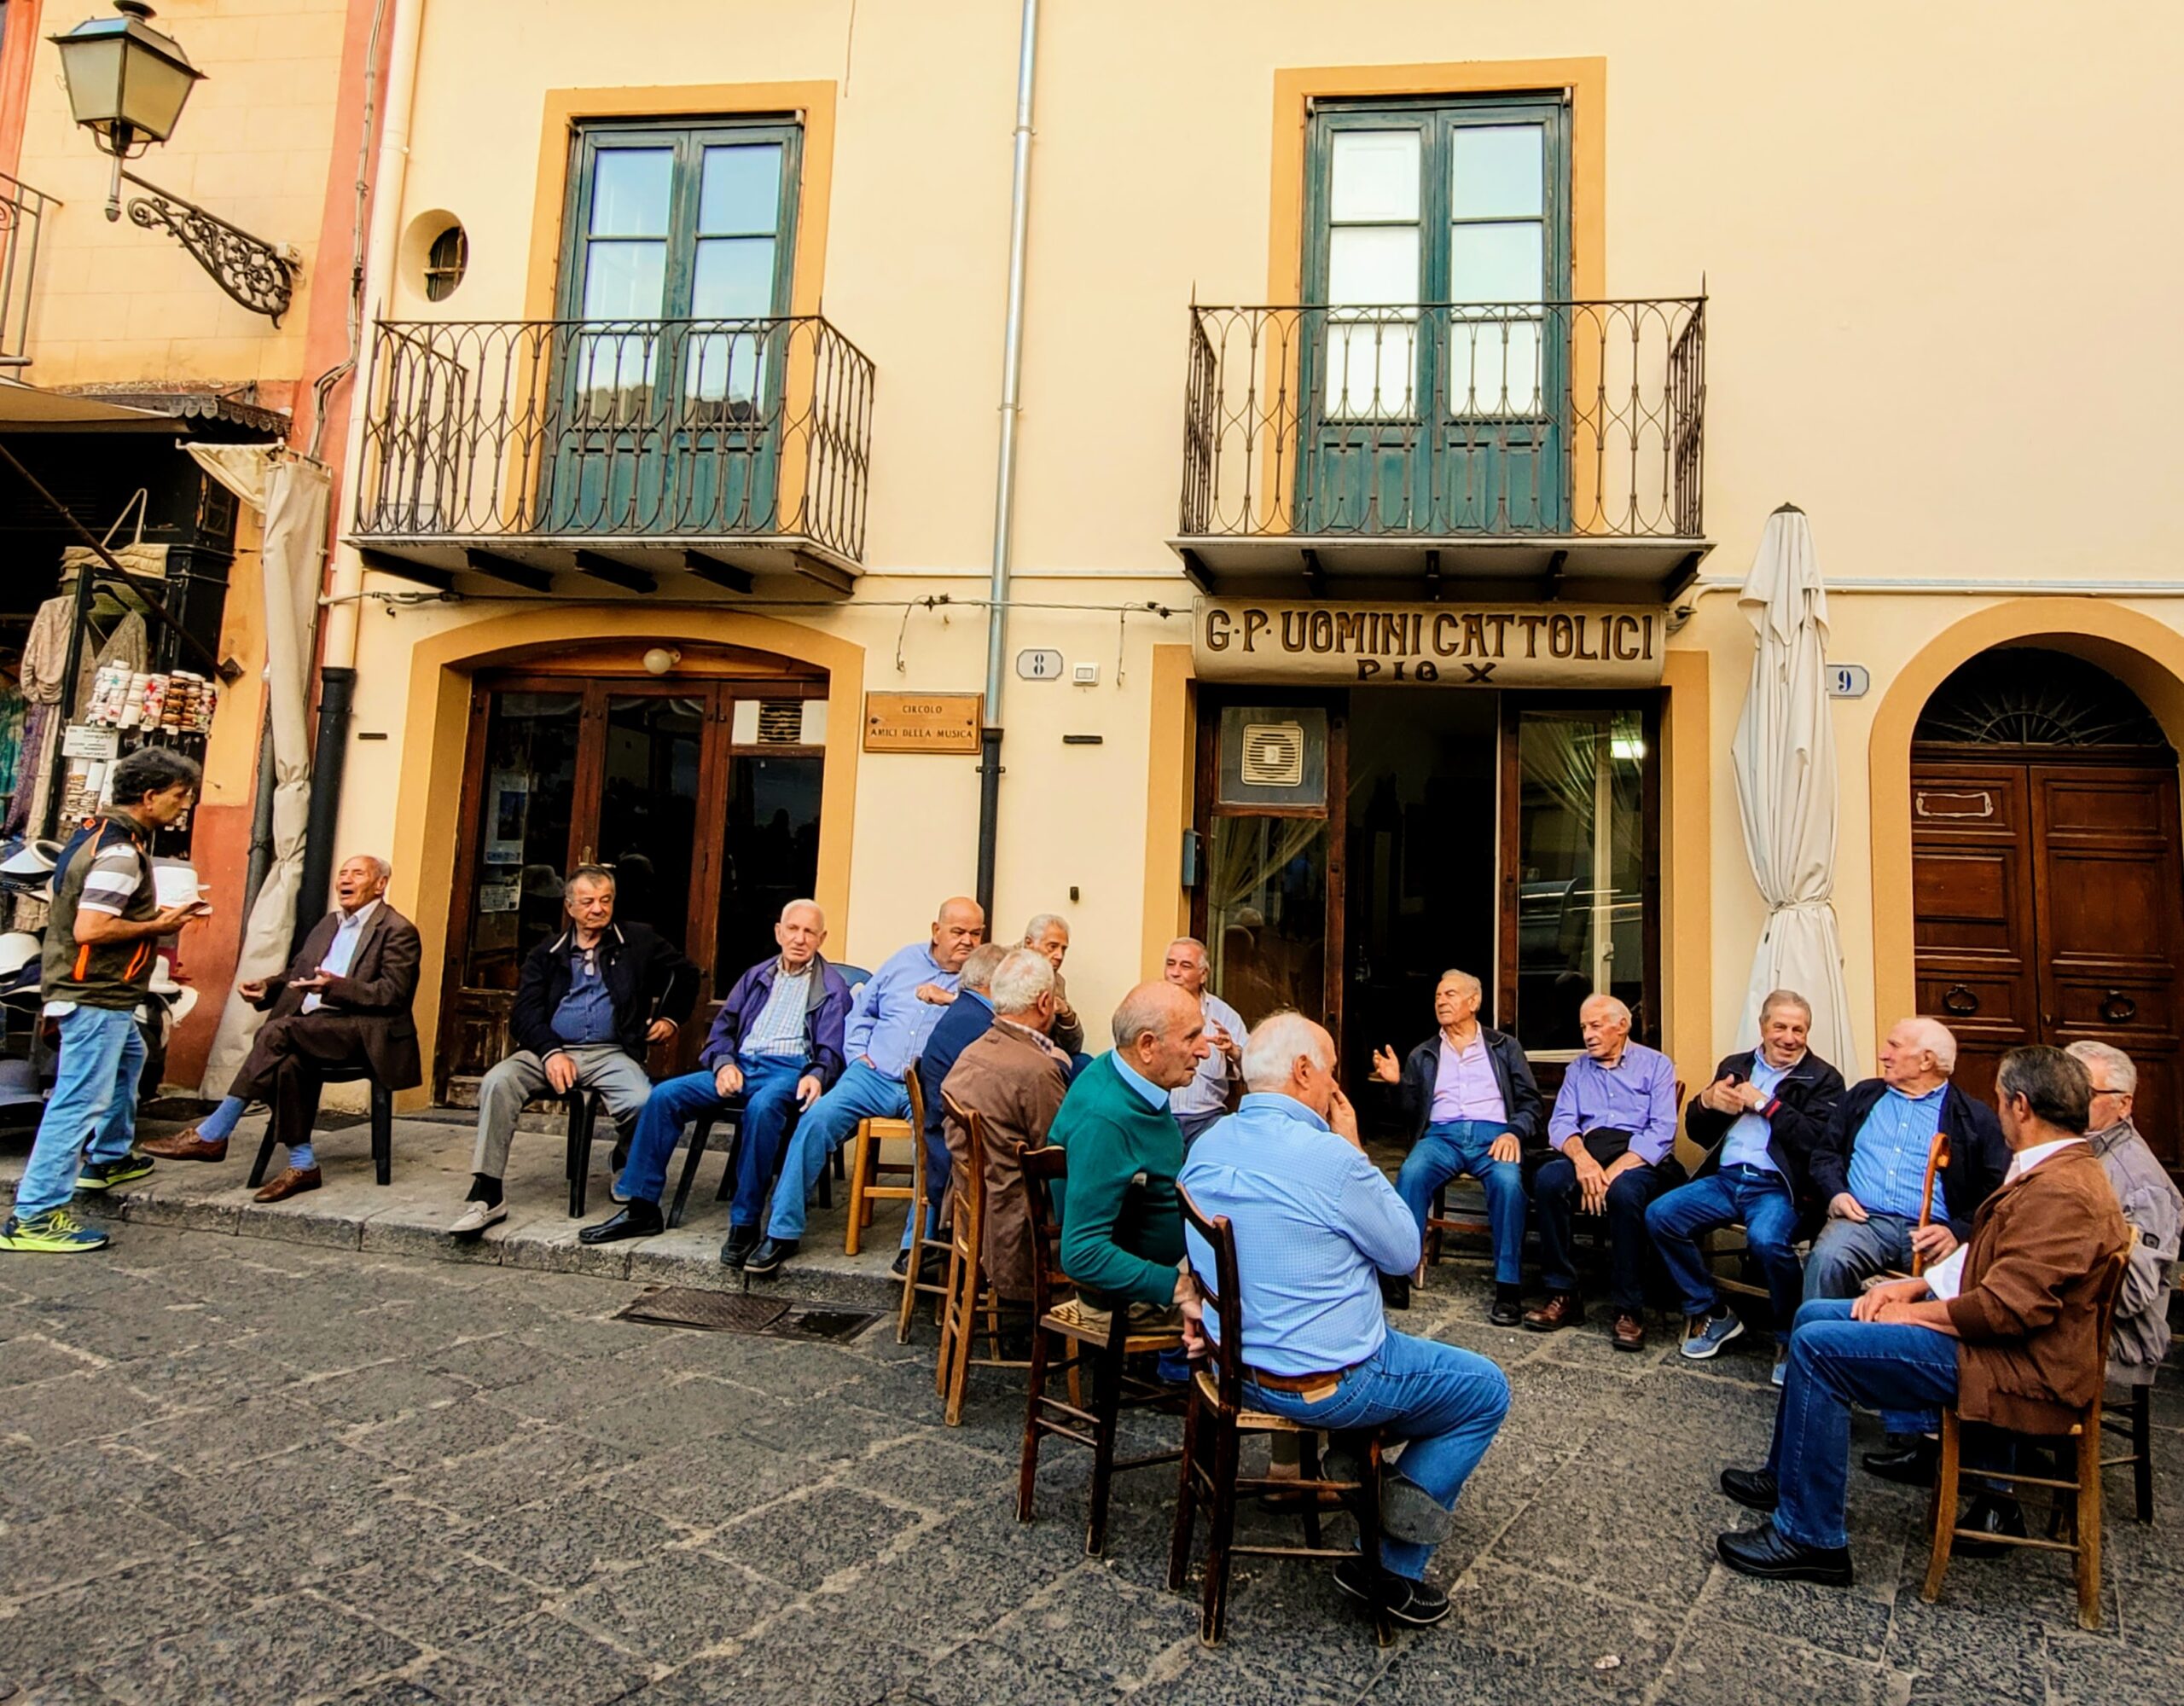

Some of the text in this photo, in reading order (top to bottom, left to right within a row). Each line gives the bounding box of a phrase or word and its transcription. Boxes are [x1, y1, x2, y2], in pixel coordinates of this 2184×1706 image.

[1280, 610, 1423, 656] UOMINI
[1432, 613, 1653, 661] CATTOLICI
[1033, 653, 1044, 676] 8
[1356, 659, 1497, 682] PIO X
[1838, 670, 1851, 693] 9
[902, 705, 943, 715] CIRCOLO
[870, 728, 973, 739] AMICI DELLA MUSICA
